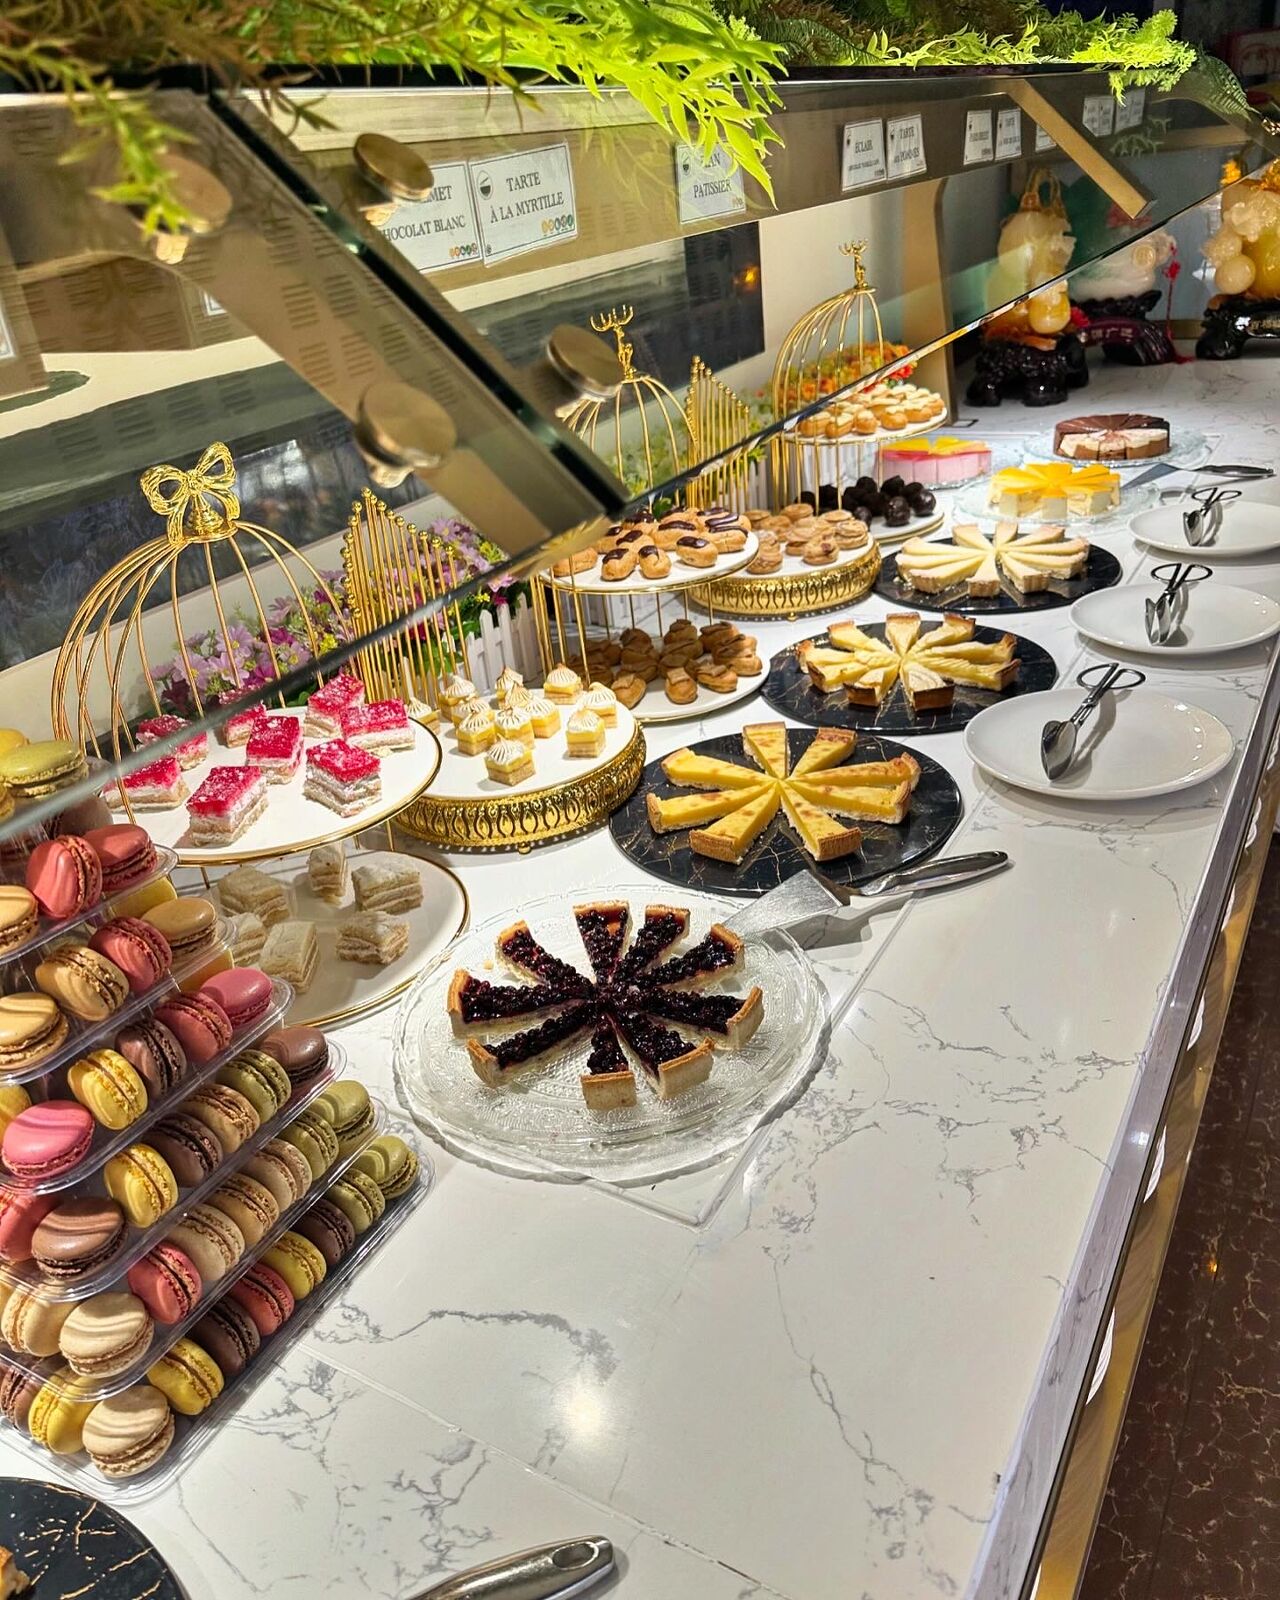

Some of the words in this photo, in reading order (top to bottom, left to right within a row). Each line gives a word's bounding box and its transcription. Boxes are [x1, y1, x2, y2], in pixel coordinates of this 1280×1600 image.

[506, 171, 541, 192] TARTE
[693, 179, 732, 198] PATISSIER
[490, 205, 500, 224] À
[500, 203, 514, 221] LA
[516, 191, 565, 217] MYRTILLE
[382, 220, 432, 242] HOCOLAT
[433, 215, 467, 233] BLANC
